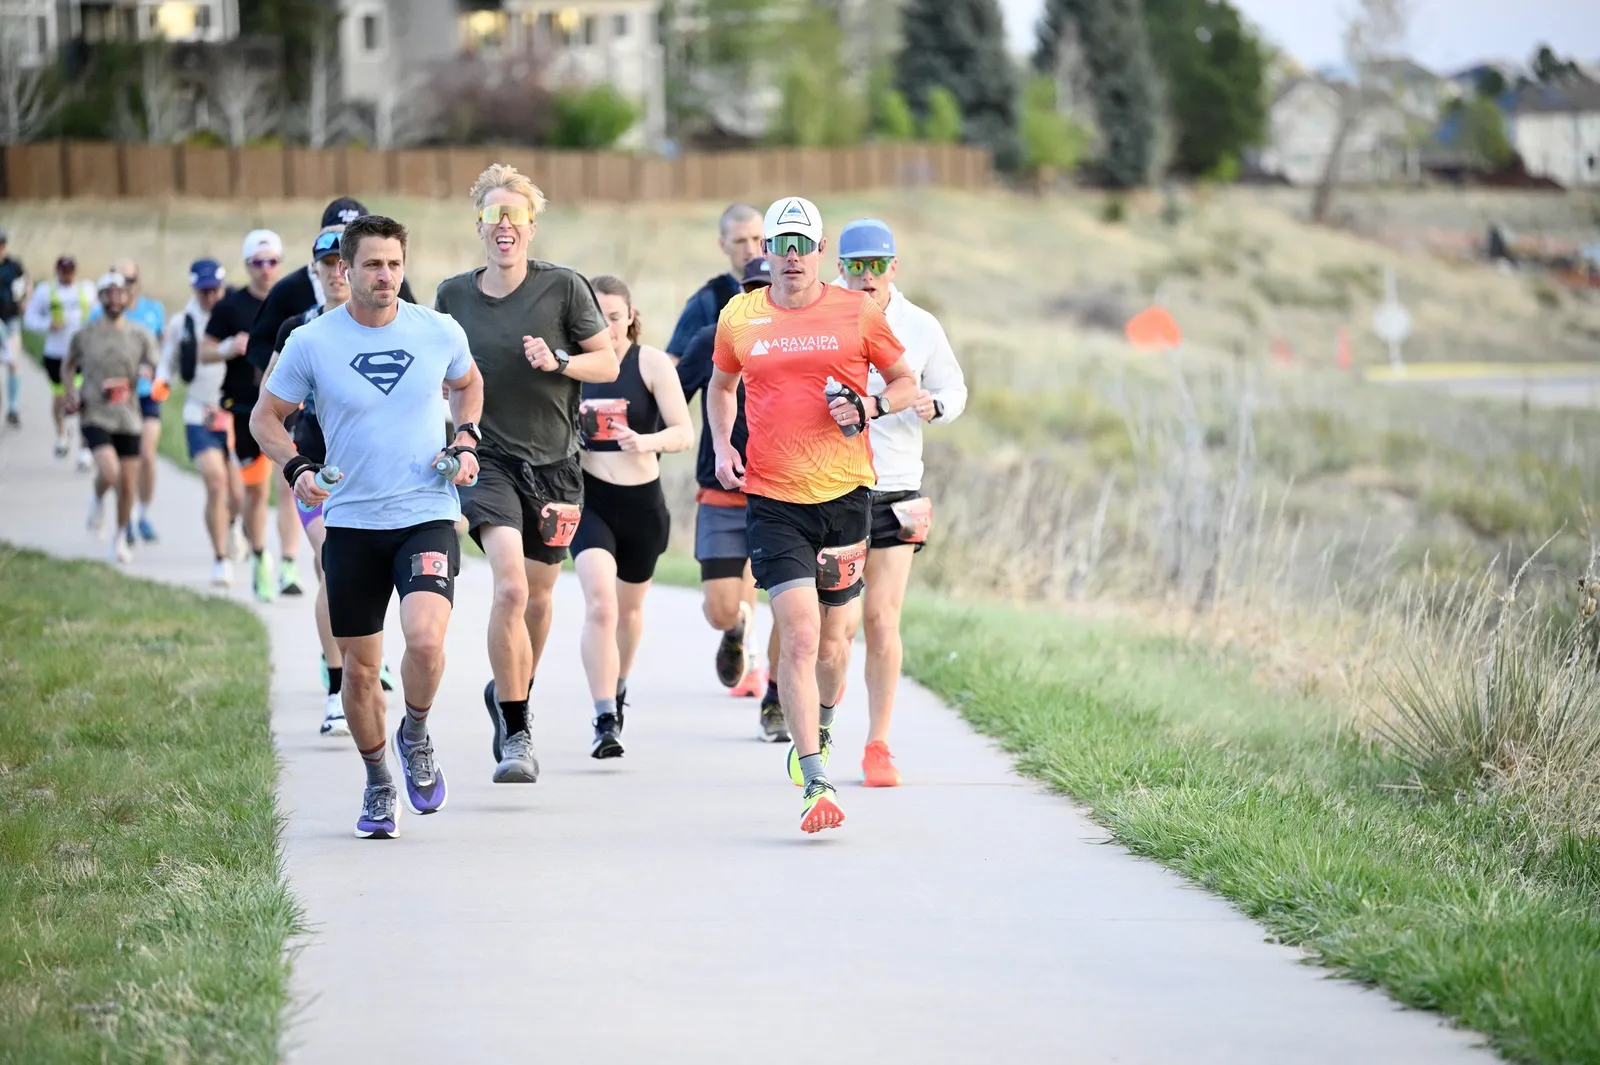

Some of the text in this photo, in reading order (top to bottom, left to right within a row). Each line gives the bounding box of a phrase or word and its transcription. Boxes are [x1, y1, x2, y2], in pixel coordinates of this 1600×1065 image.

[771, 335, 838, 348] ARAVAIPA
[560, 522, 577, 536] 17
[432, 560, 443, 573] 9
[847, 562, 856, 577] 3
